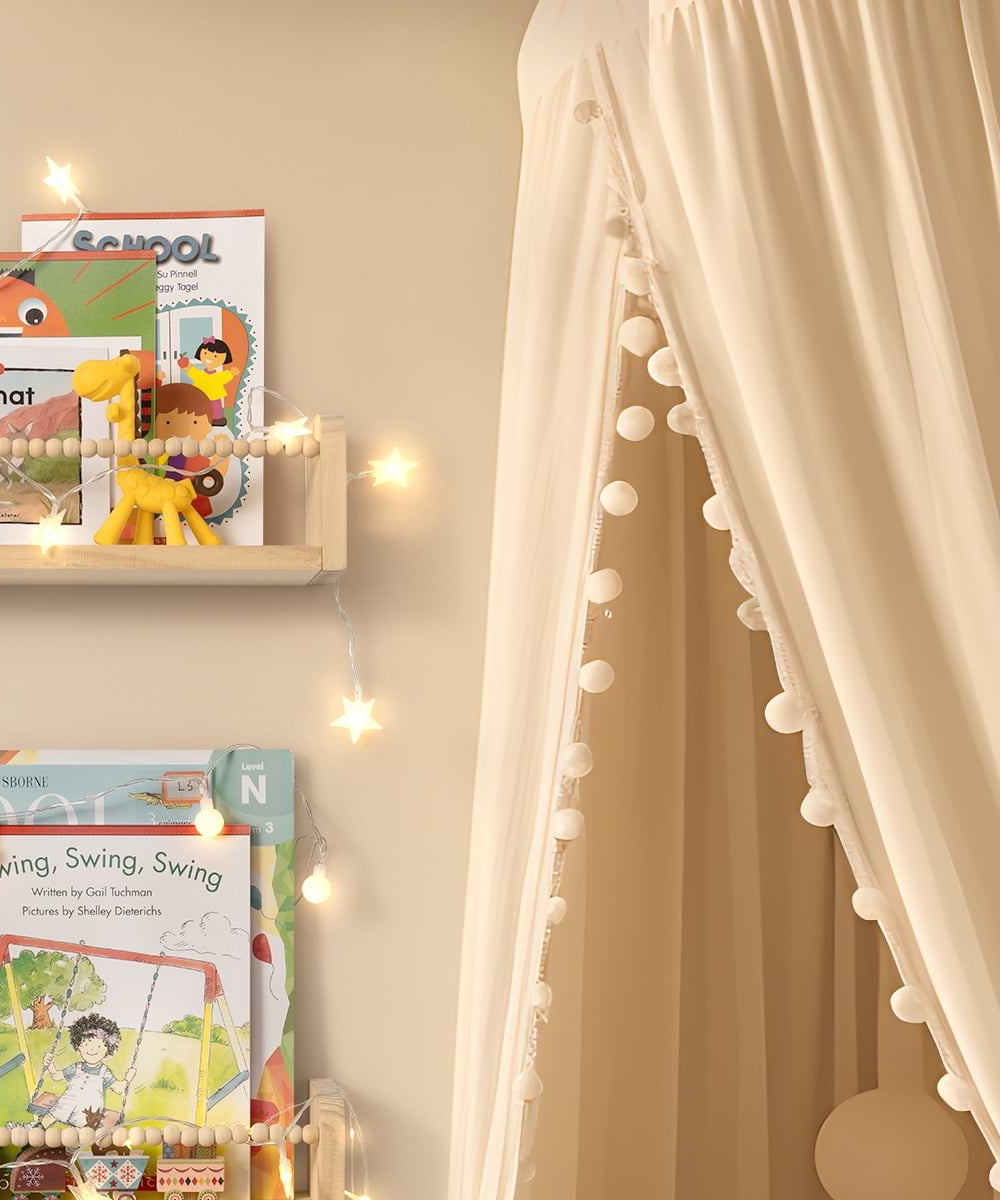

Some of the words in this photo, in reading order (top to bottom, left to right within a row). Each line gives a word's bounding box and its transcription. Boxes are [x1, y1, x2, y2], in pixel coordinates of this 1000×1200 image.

[73, 229, 217, 262] SCHOOL
[157, 270, 168, 278] Su
[170, 269, 197, 278] Pinnell
[156, 284, 174, 293] eggy
[177, 282, 198, 292] Tagel
[241, 762, 264, 771] Level
[241, 775, 266, 804] N
[265, 821, 274, 834] 3
[65, 847, 144, 877] Swing,
[152, 851, 223, 893] Swing
[31, 886, 68, 897] Written
[70, 886, 83, 898] by
[85, 886, 107, 897] Gail
[110, 886, 153, 897] Tuchman
[22, 905, 59, 916] Pictures
[62, 906, 75, 917] by
[78, 905, 112, 917] Shelley
[114, 905, 162, 916] Dieterichs
